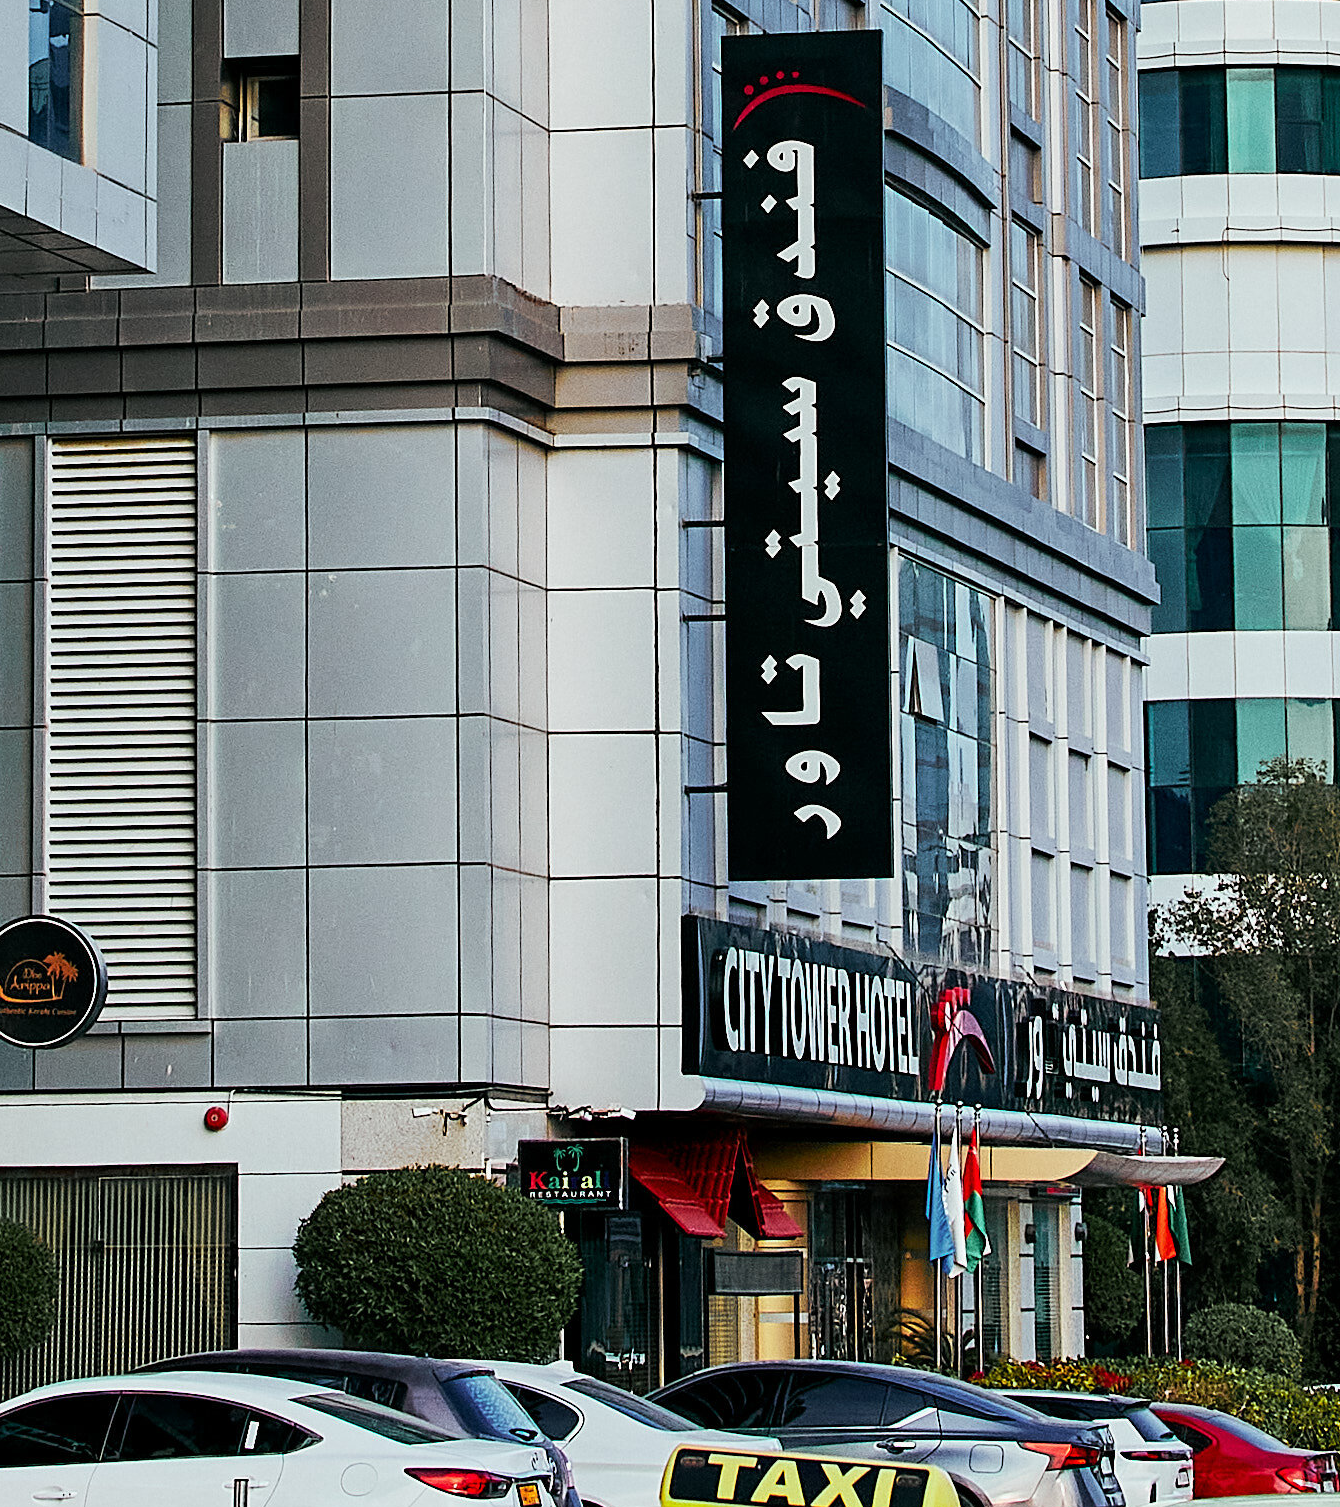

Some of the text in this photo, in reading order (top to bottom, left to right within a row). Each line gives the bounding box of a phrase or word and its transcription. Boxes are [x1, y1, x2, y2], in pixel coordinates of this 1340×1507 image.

[743, 139, 867, 840] فندق سيتي تاور
[724, 947, 920, 1075] CITY TOWER HOTEL
[1062, 1009, 1110, 1103] سيتي
[1113, 1017, 1161, 1091] فندق
[528, 1170, 611, 1190] Kairali
[529, 1190, 612, 1199] RESTAURANT
